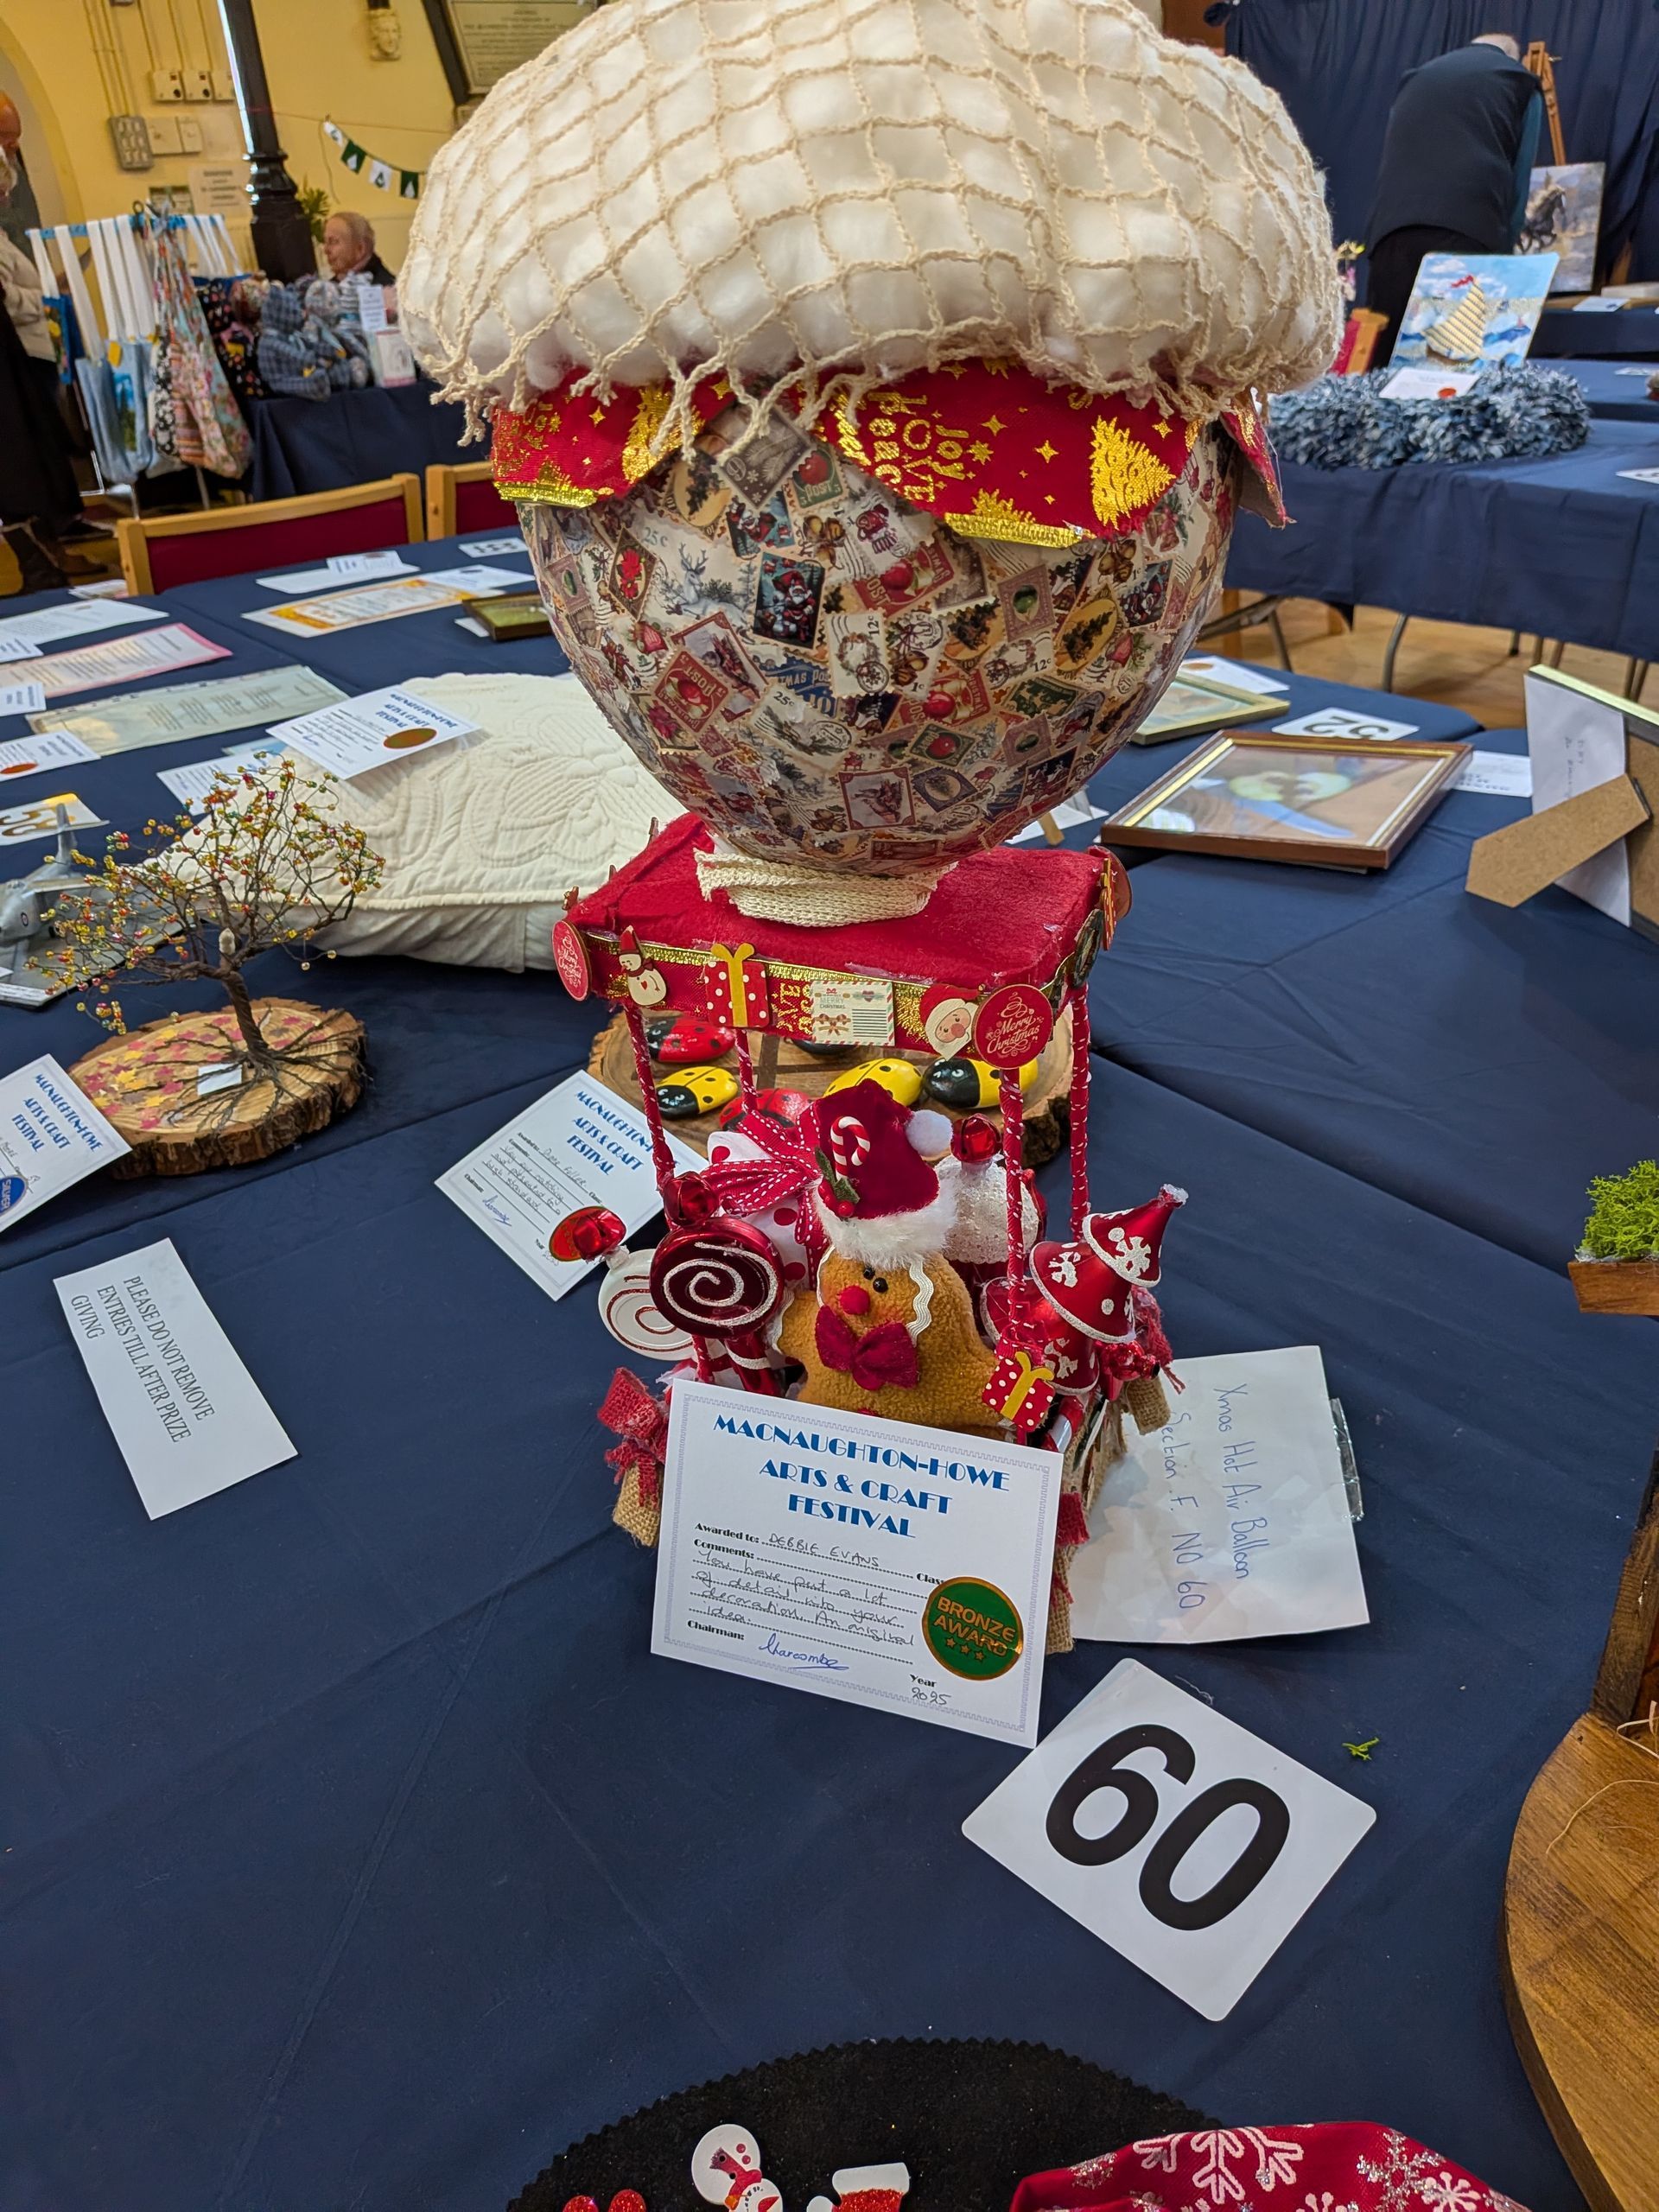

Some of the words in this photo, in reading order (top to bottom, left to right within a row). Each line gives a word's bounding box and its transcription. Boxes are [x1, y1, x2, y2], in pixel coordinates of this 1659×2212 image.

[987, 1025, 1040, 1054] Christmas
[1002, 1014, 1036, 1035] Merry
[567, 1135, 614, 1175] FESTIVAL
[573, 1116, 602, 1139] ARTS
[607, 1141, 644, 1171] CRAFT
[71, 1294, 105, 1339] GIVING
[123, 1275, 161, 1322] PLEASE
[147, 1319, 170, 1341] DO
[97, 1285, 136, 1337] ENTRIES
[123, 1334, 149, 1365] TILL
[136, 1364, 171, 1405] AFTER
[156, 1401, 192, 1443] PRIZE
[156, 1338, 186, 1366] NOT
[171, 1364, 215, 1421] REMOVE
[1214, 1382, 1248, 1433] Xmas
[713, 1414, 1010, 1491] MACNAUGHTON-HOWE
[1223, 1440, 1258, 1473] Hot
[759, 1459, 828, 1487] ARTS
[834, 1474, 853, 1493] &
[861, 1480, 952, 1514] CRAFT
[1222, 1484, 1262, 1510] Air
[695, 1522, 743, 1540] Awarded
[745, 1534, 760, 1544] to:
[788, 1494, 916, 1538] FESTIVAL
[694, 1538, 754, 1560] Comments:
[769, 1533, 818, 1554] DEBBIE
[830, 1546, 880, 1567] EVANS
[1230, 1517, 1270, 1580] Balloon
[698, 1550, 731, 1570] You
[744, 1559, 781, 1580] have
[794, 1576, 827, 1593] put
[839, 1589, 851, 1599] a
[1177, 1580, 1208, 1609] 60
[729, 1578, 790, 1599] detail
[852, 1607, 898, 1625] your
[815, 1610, 840, 1628] An
[937, 1596, 1016, 1643] BRONZE
[687, 1619, 745, 1641] Chairman:
[933, 1615, 1008, 1657] AWARD
[910, 1674, 937, 1688] Year
[912, 1687, 951, 1706] 2025
[1045, 1723, 1291, 1931] 60
